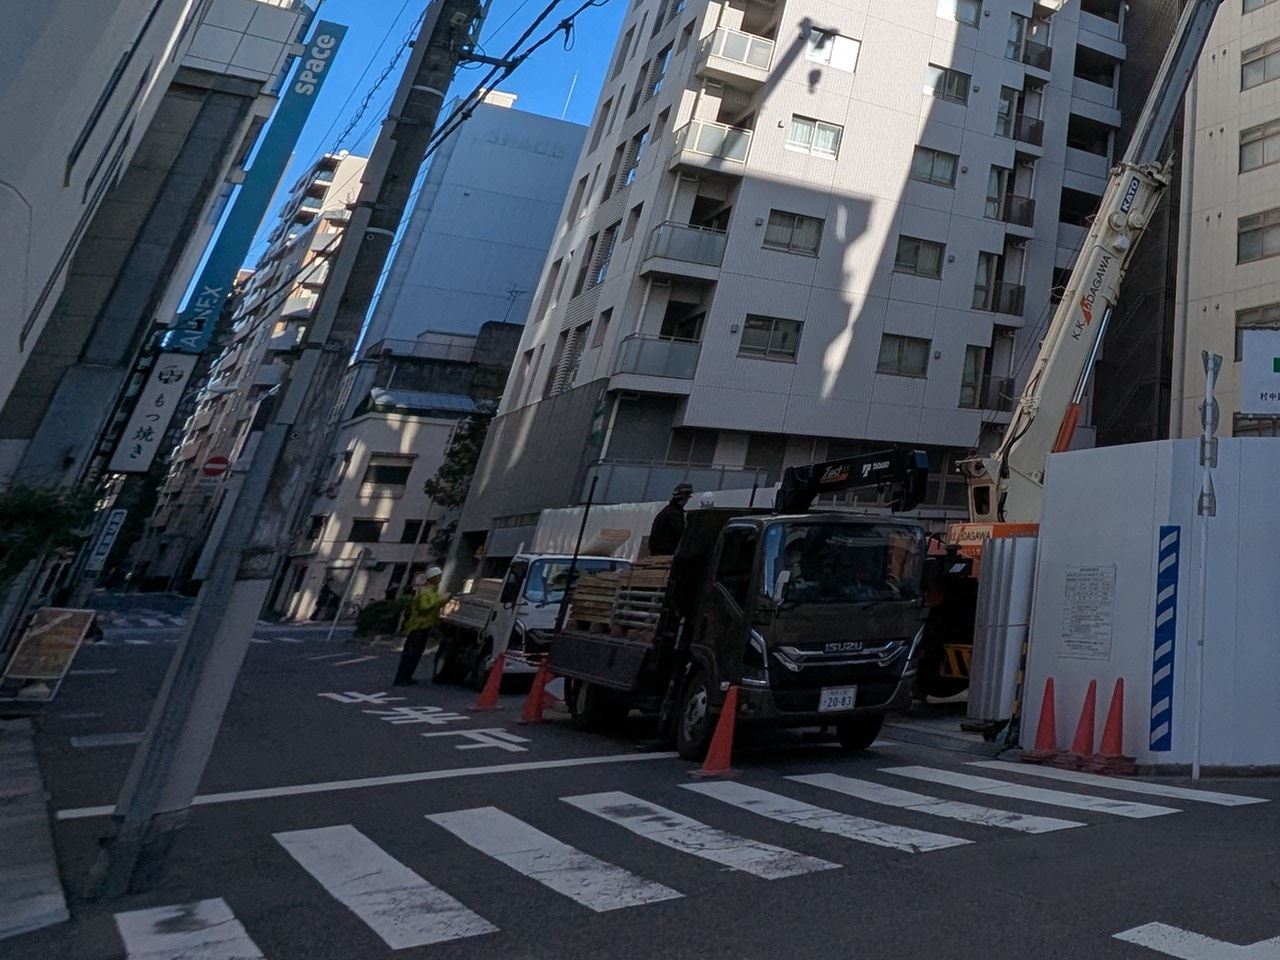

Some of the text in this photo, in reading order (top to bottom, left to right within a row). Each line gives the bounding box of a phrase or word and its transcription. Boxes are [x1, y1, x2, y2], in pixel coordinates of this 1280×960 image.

[1121, 178, 1140, 212] KATO
[130, 393, 165, 459] もつ焼き
[825, 641, 863, 652] ISUZU
